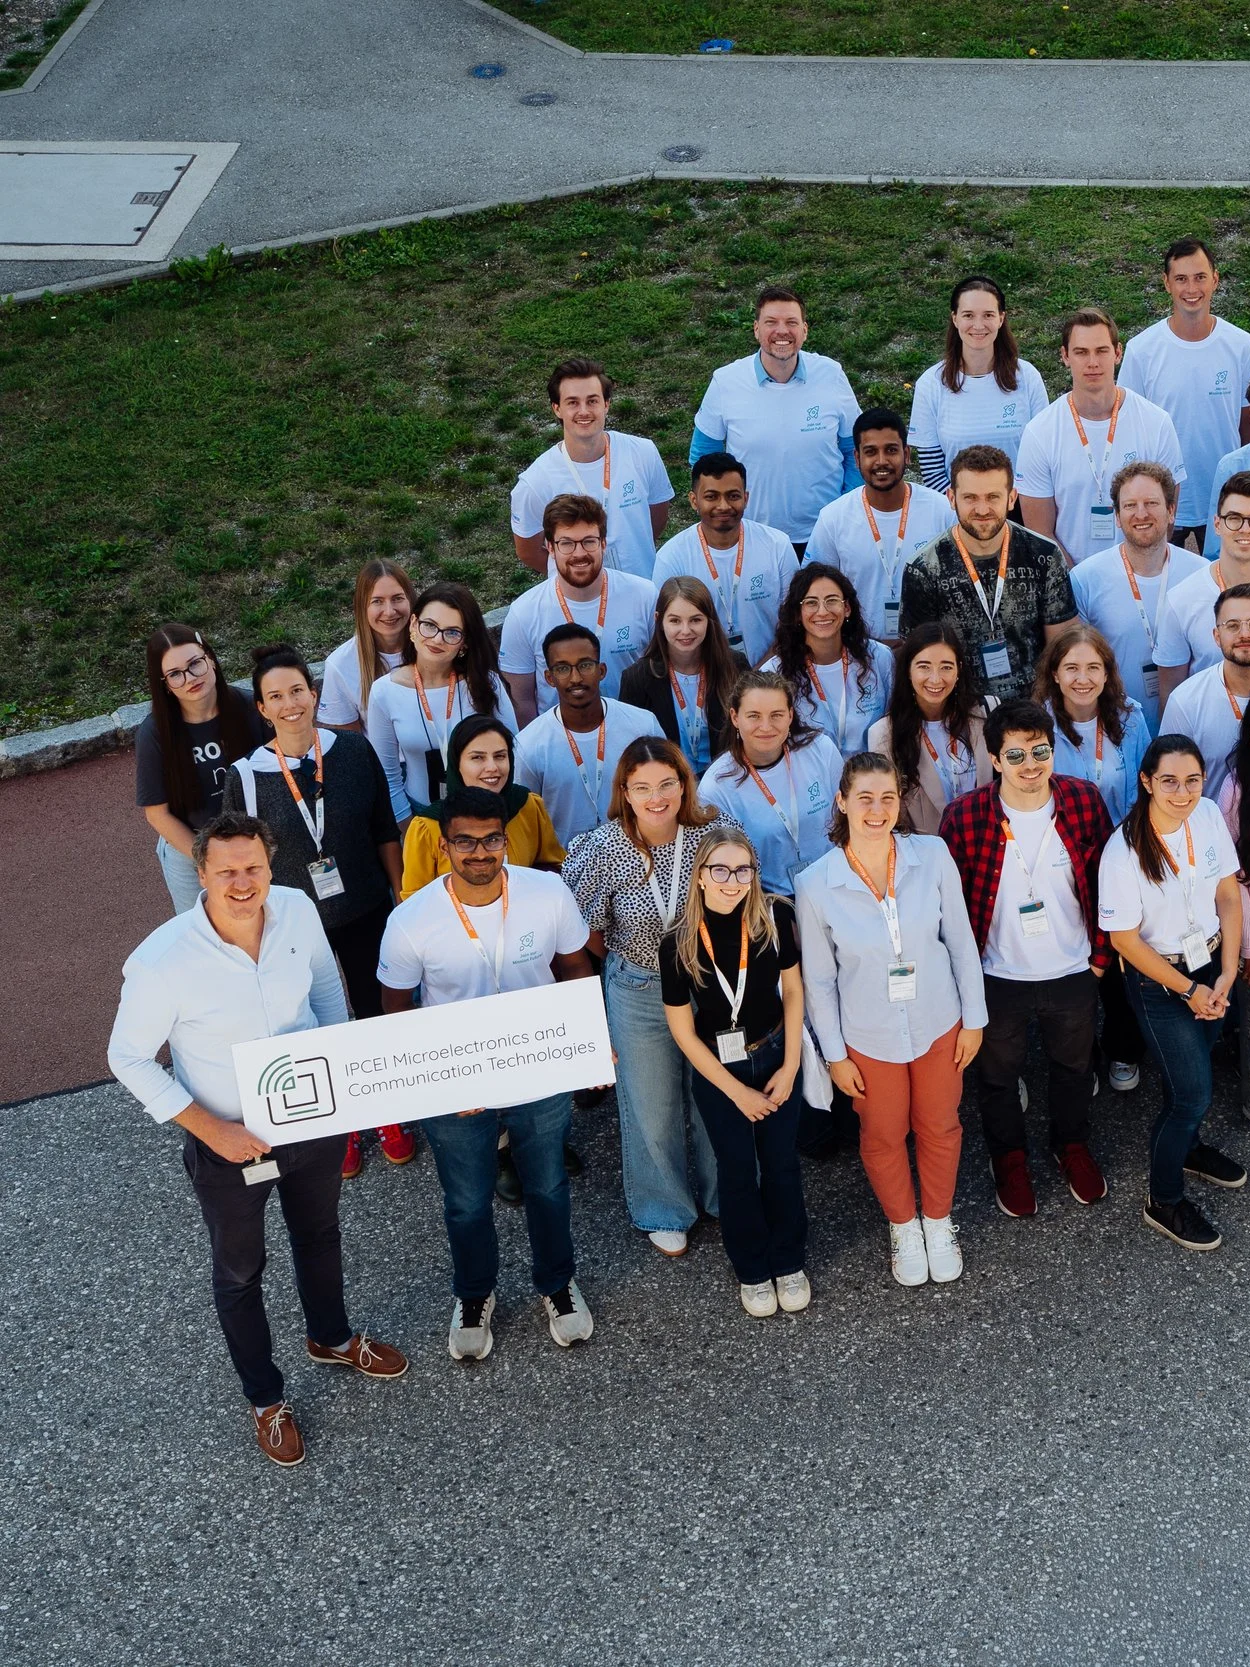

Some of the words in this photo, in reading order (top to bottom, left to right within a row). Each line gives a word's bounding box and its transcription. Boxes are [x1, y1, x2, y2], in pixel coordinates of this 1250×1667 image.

[344, 1056, 388, 1077] IPCEI
[393, 1031, 530, 1068] Microelectronics
[534, 1022, 567, 1042] and
[348, 1060, 482, 1098] Communication
[486, 1040, 597, 1072] Technologies
